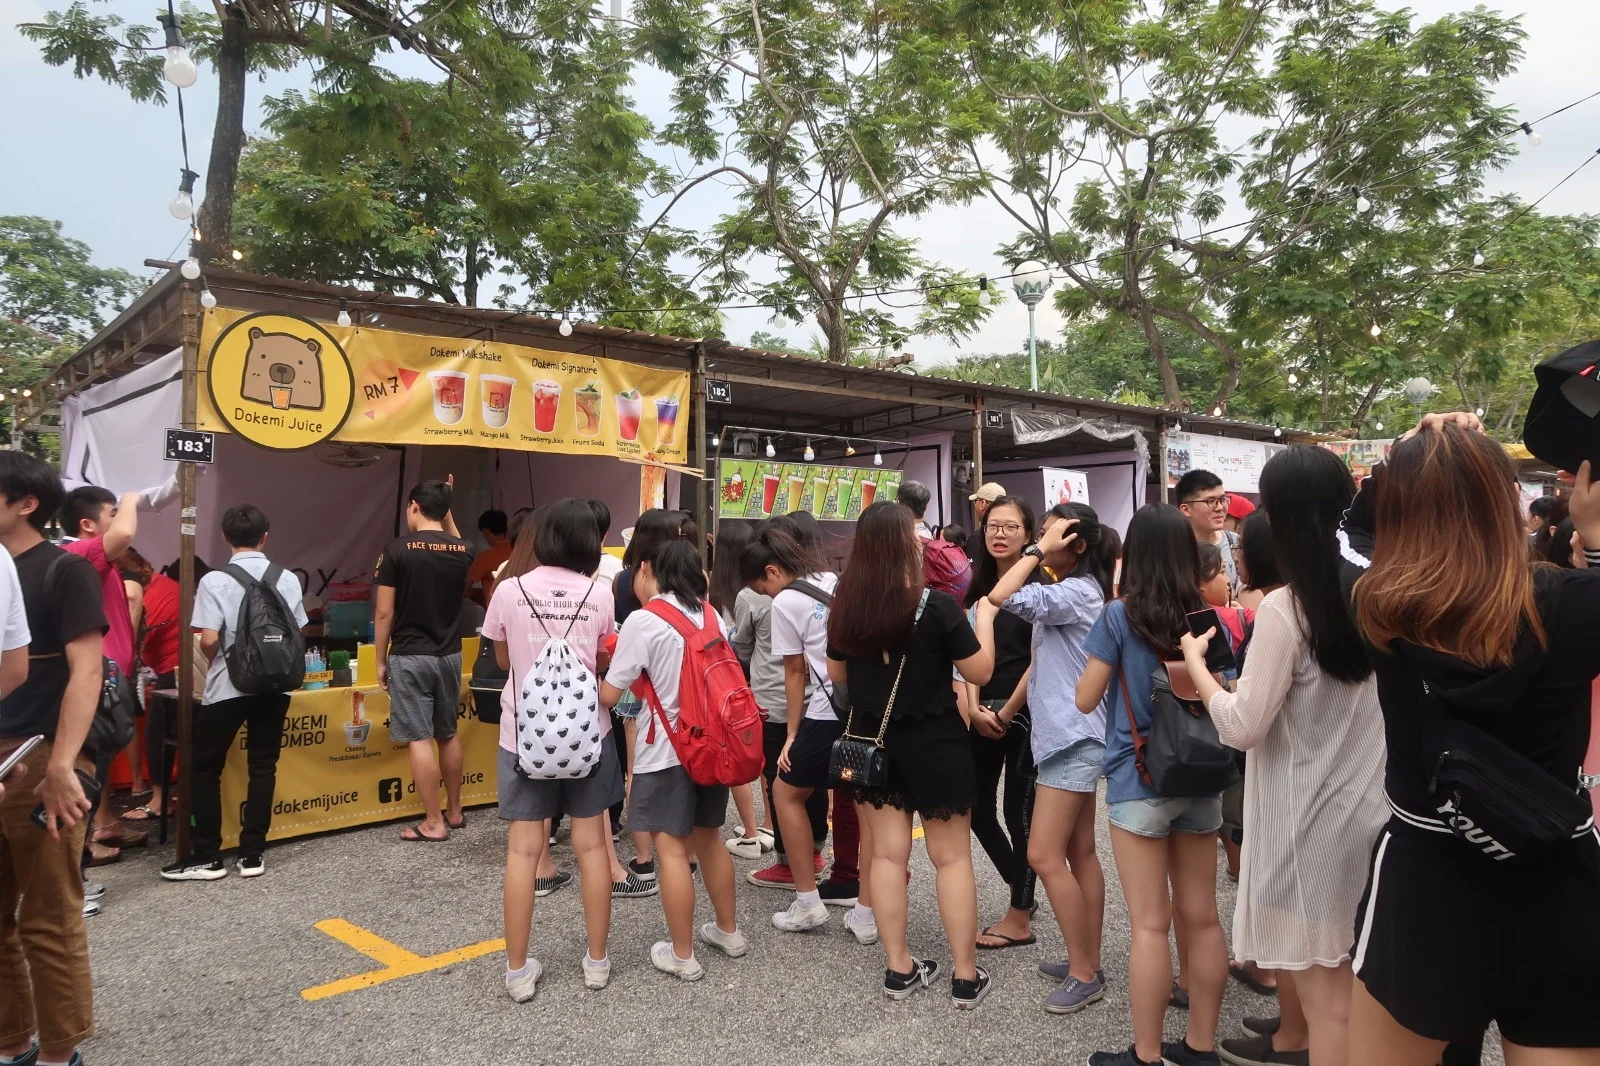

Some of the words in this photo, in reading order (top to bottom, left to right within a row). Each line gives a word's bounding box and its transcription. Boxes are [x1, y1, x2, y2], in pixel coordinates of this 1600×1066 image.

[429, 346, 460, 358] Dokemi
[462, 349, 502, 363] Milkshake
[531, 358, 560, 370] Dokemi
[561, 362, 598, 375] Signature
[363, 383, 387, 401] RM
[387, 376, 400, 394] 7
[712, 387, 726, 397] 182
[234, 407, 284, 428] Dokemi
[288, 417, 323, 433] Juice
[990, 415, 999, 423] 181
[423, 427, 462, 436] Strawberry
[480, 430, 499, 440] Mango
[176, 439, 204, 453] 183
[406, 542, 426, 550] FACE
[428, 543, 448, 552] YOUR
[448, 544, 466, 553] FEAR
[553, 600, 573, 609] HIGH
[282, 715, 327, 732] OKEMI
[279, 731, 325, 748] OMBO
[273, 791, 359, 815] dokemijuice
